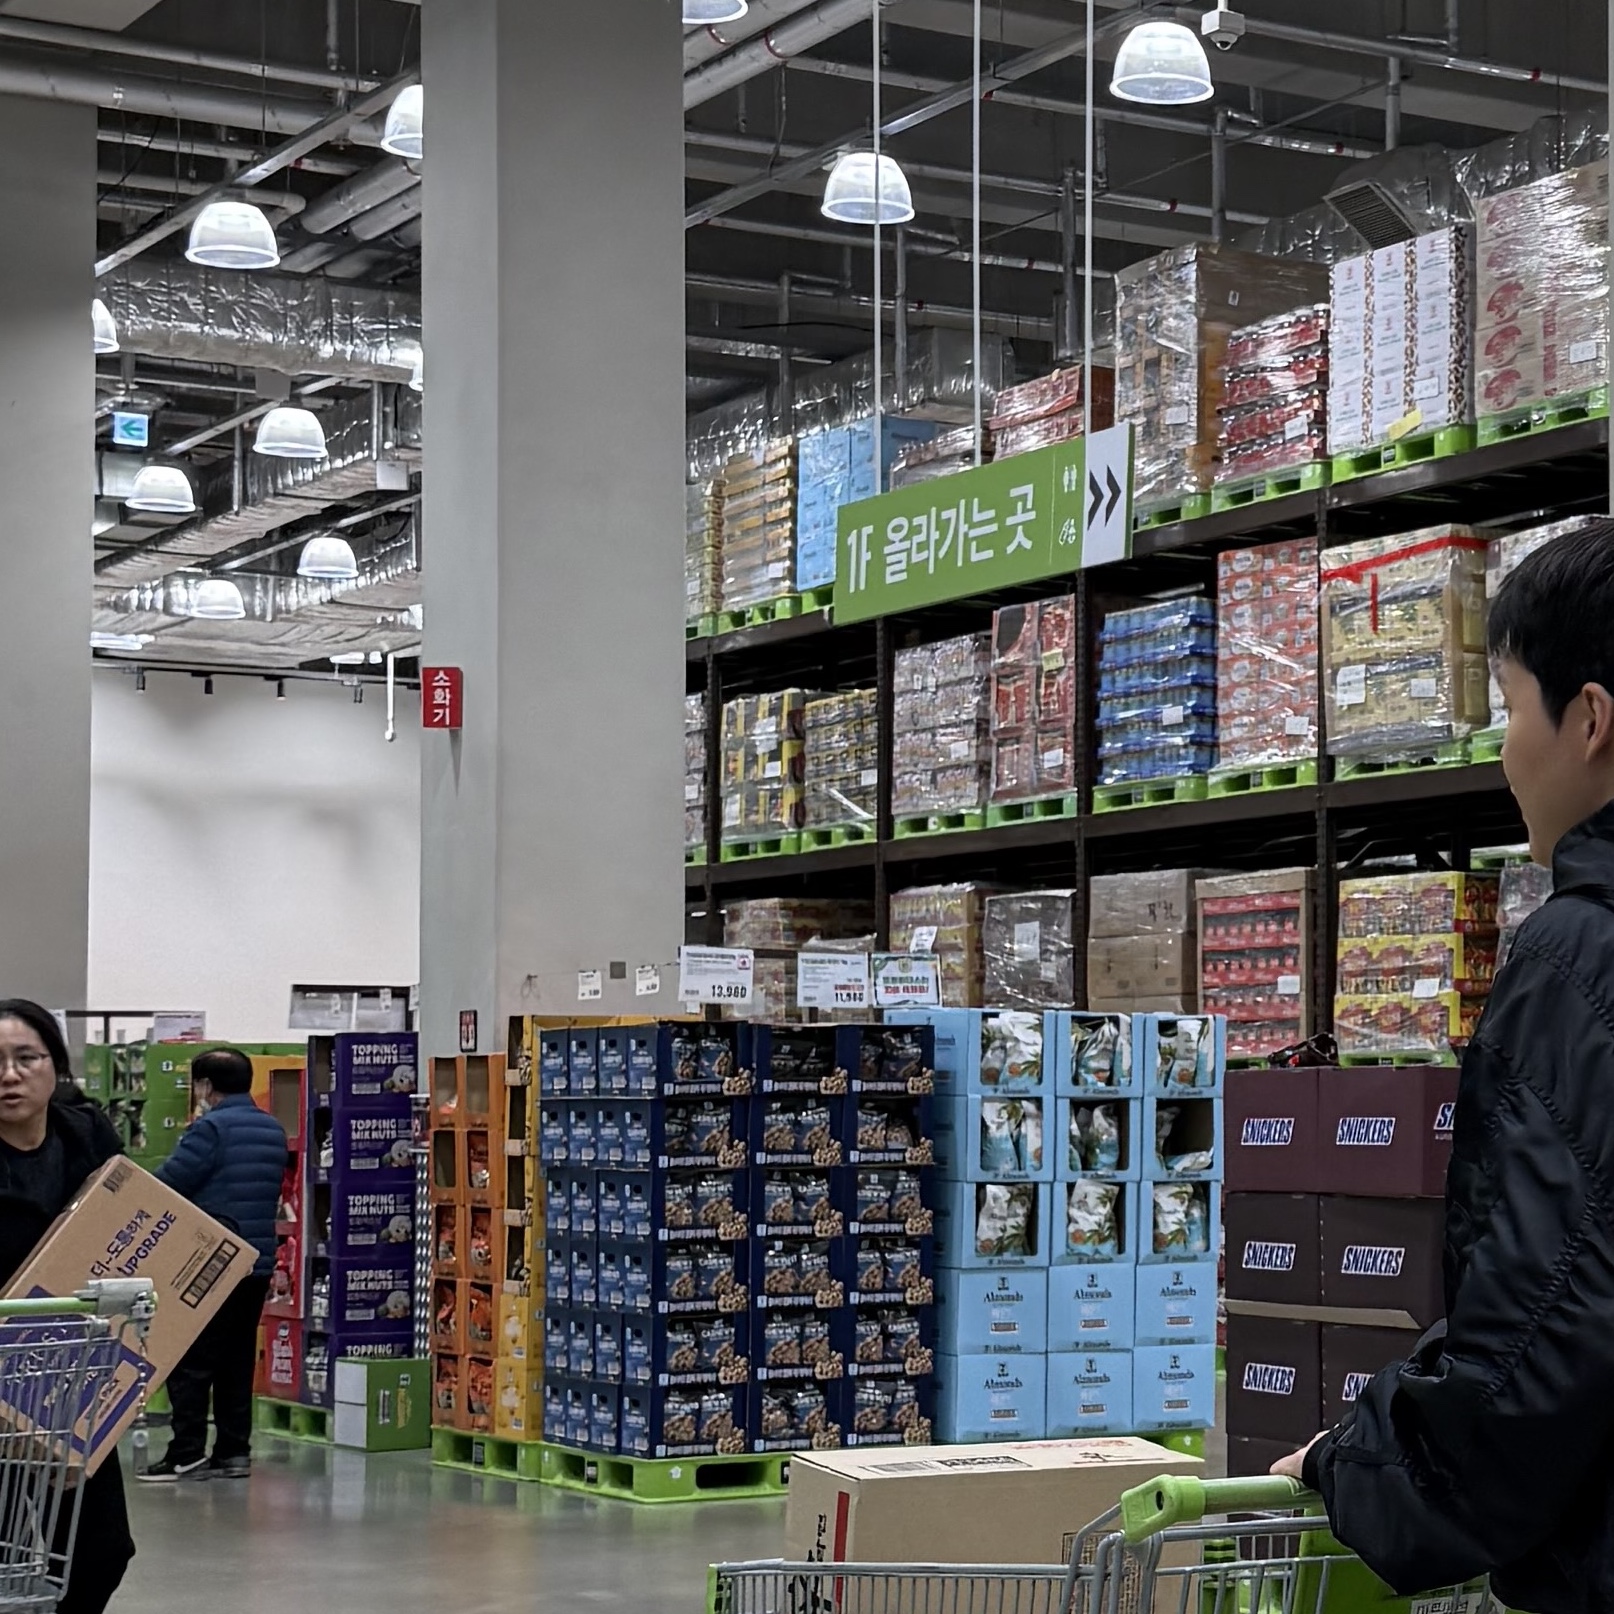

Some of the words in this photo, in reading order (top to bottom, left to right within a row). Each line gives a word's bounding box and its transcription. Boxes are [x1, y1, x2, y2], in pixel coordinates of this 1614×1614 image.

[847, 525, 873, 593] 1F
[883, 498, 998, 584] 올라가는
[1005, 484, 1036, 554] 곳
[432, 670, 451, 725] 소화기
[352, 1044, 398, 1055] TOPPING
[351, 1119, 396, 1130] TOPPING
[1242, 1118, 1293, 1144] SNICKERS
[1336, 1117, 1395, 1145] SNICKERS
[348, 1194, 394, 1205] TOPPING
[117, 1210, 176, 1276] UPGRADE
[1243, 1242, 1296, 1271] SNICKERS
[1342, 1246, 1404, 1276] SNICKERS
[347, 1270, 392, 1281] TOPPING
[984, 1292, 1023, 1302] Almonds
[1074, 1289, 1112, 1300] Almonds
[1160, 1287, 1197, 1297] Almonds
[347, 1344, 392, 1356] TOPPING
[1073, 1374, 1110, 1384] Almonds
[1158, 1369, 1194, 1380] Almonds
[1243, 1363, 1295, 1395] SNICKERS
[984, 1379, 1023, 1390] Almonds
